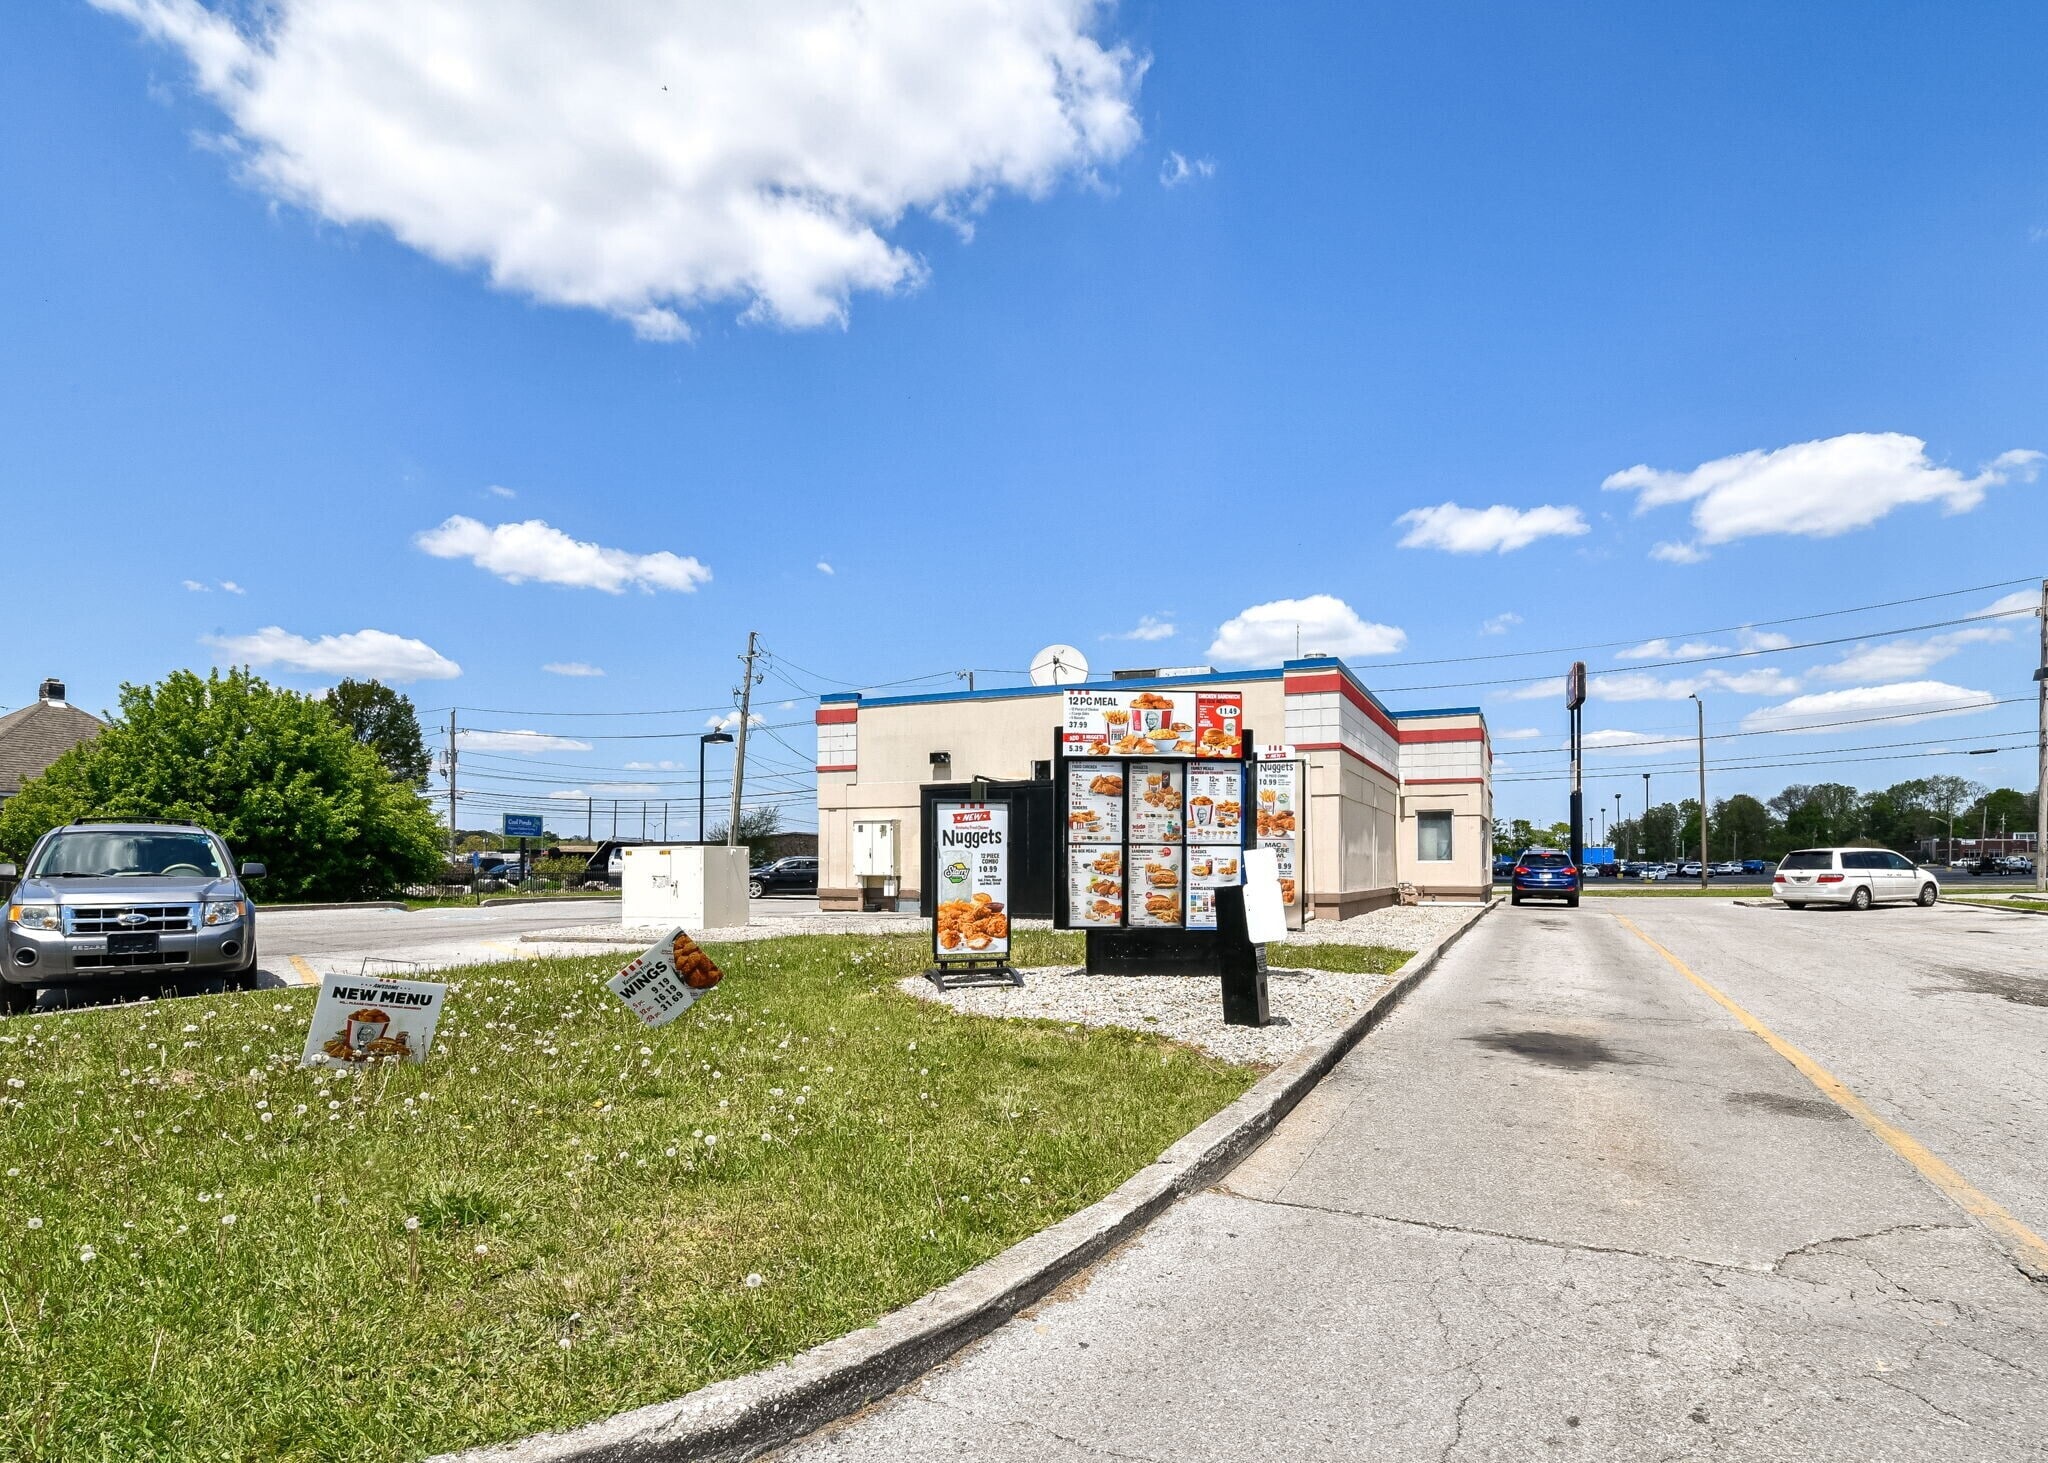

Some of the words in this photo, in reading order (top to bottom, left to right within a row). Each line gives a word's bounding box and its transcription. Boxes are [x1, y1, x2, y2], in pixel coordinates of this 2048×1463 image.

[1068, 697, 1079, 706] 12
[1080, 697, 1092, 706] PC
[1094, 697, 1118, 706] MEAL
[1260, 763, 1293, 773] Nuggets
[962, 813, 982, 821] NEW
[942, 829, 1002, 848] Nuggets
[619, 961, 667, 999] WINGS
[622, 971, 642, 986] Kentucky
[640, 961, 653, 972] Fried
[651, 978, 670, 994] 9.19
[654, 985, 677, 1004] 16.19
[332, 986, 377, 1002] NEW
[380, 990, 433, 1006] MENU
[660, 992, 683, 1011] 31.69
